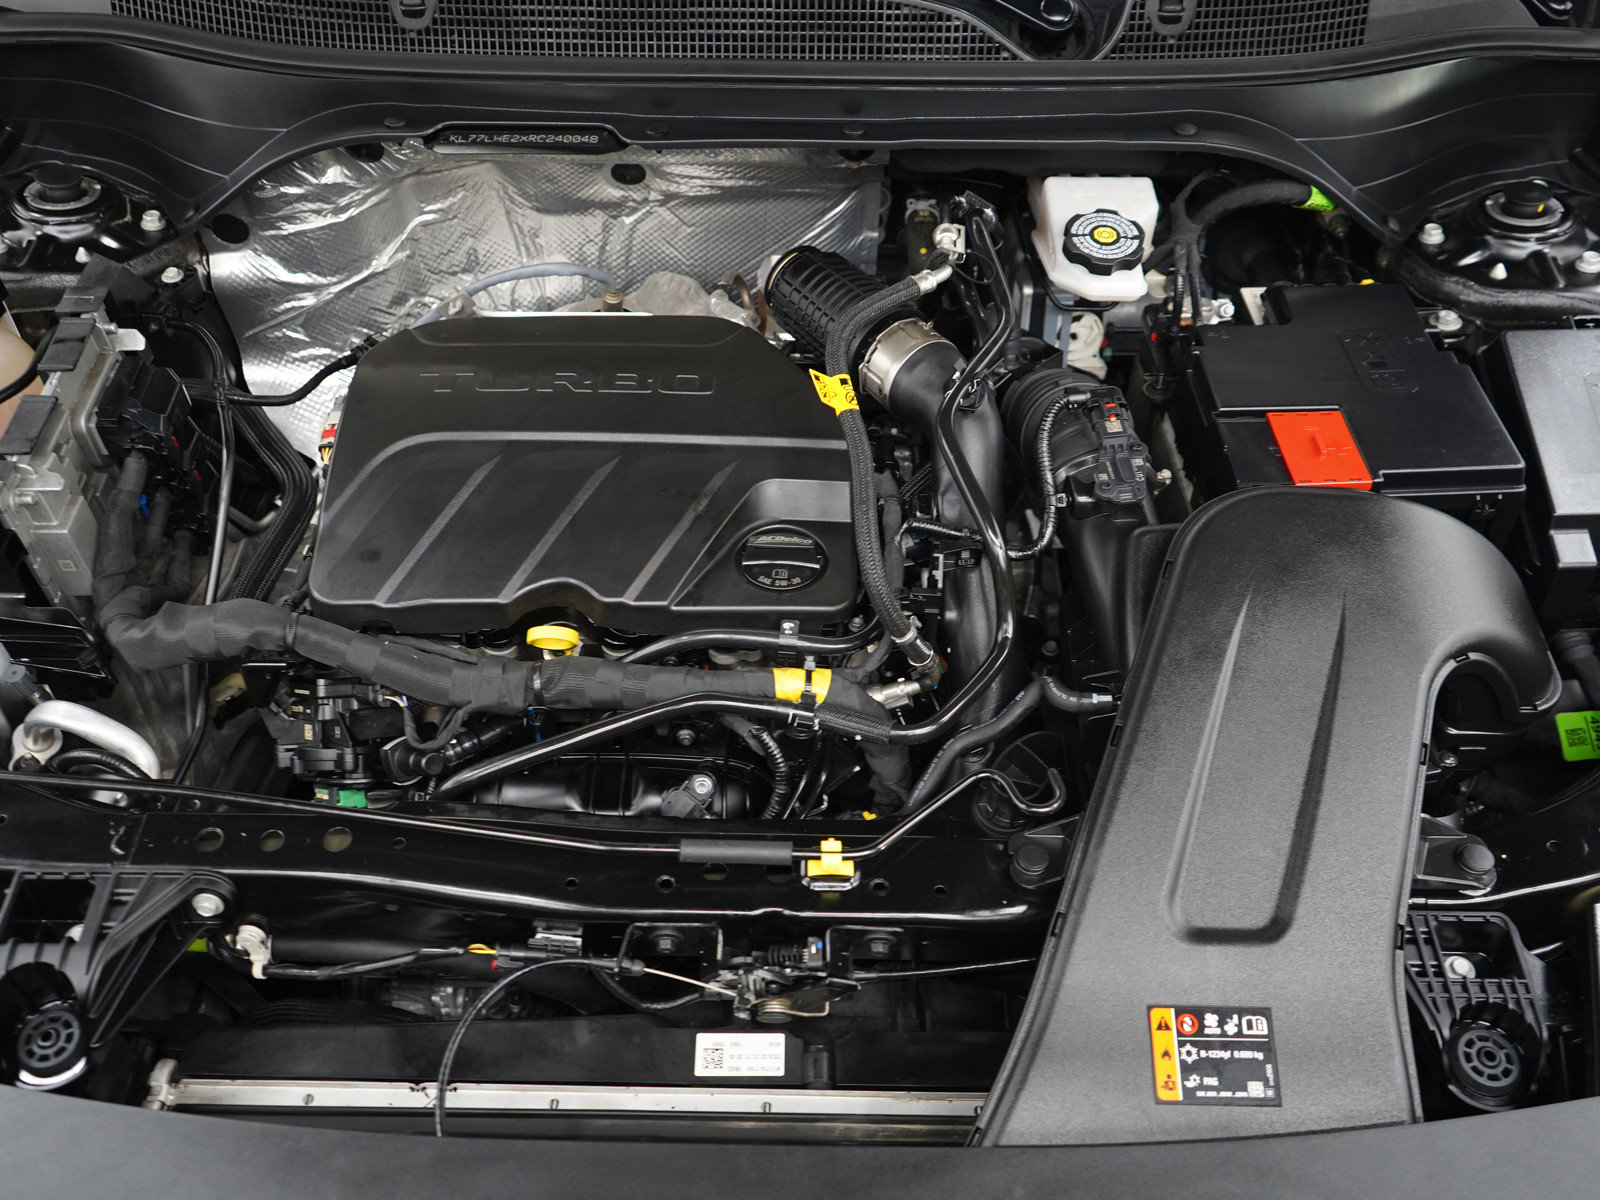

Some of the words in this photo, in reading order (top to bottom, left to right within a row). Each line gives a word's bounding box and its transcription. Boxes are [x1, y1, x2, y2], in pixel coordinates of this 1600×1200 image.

[419, 372, 716, 394] TURBO
[754, 535, 814, 544] ACDelco
[758, 575, 773, 585] SAE
[774, 577, 802, 586] 5W-30
